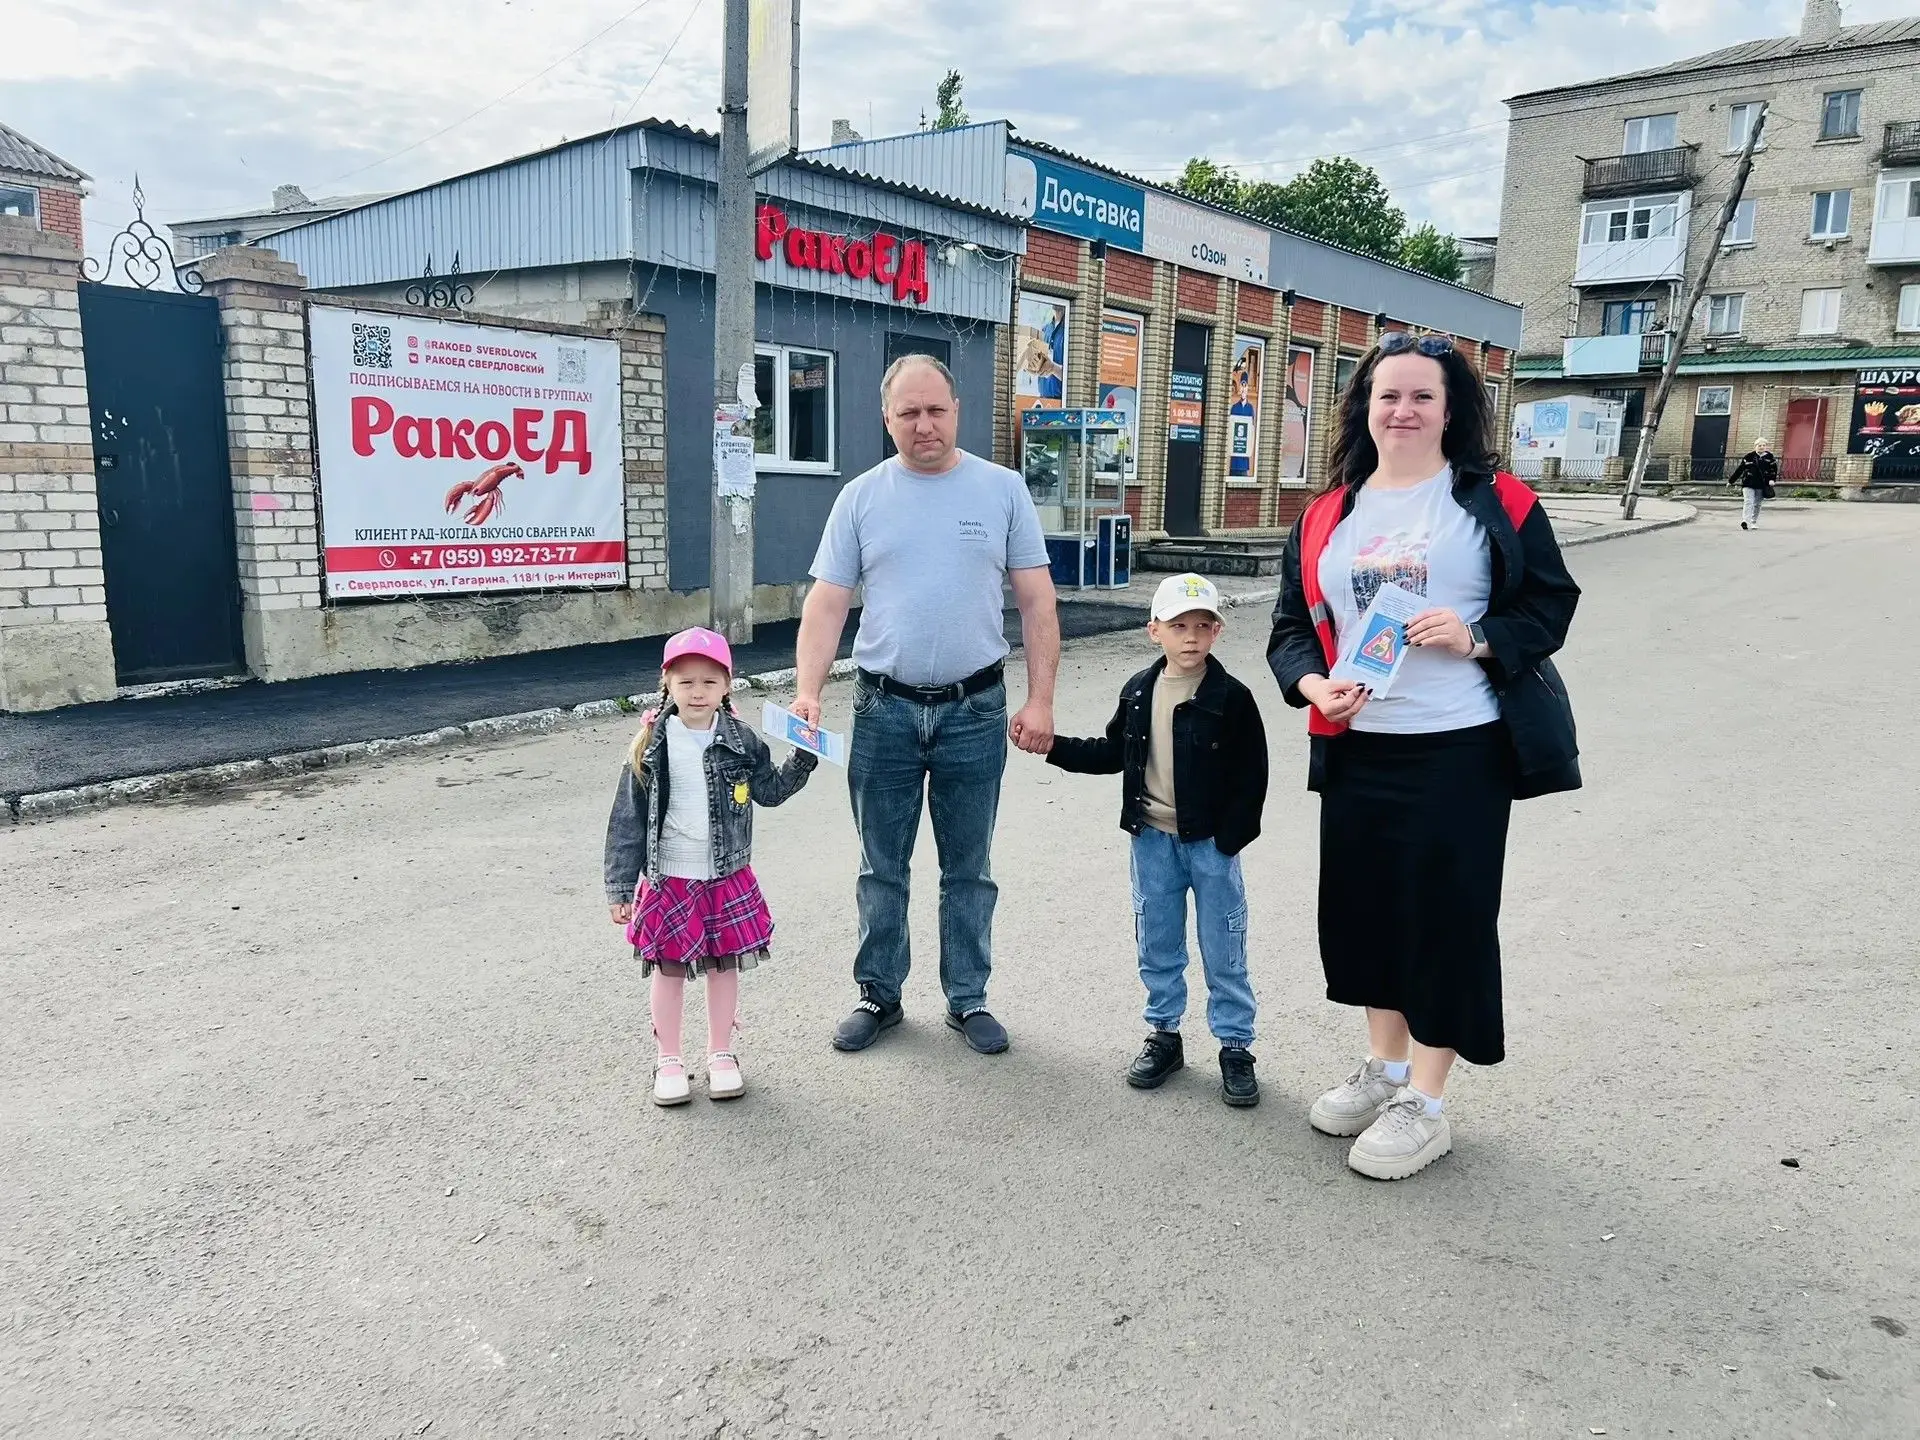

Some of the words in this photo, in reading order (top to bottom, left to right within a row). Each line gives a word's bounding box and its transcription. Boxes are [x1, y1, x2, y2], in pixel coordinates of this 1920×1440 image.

[1042, 176, 1140, 233] Доставка
[755, 204, 928, 304] РакоЕД
[1200, 243, 1227, 267] Озон
[425, 355, 466, 369] РАКОЕД
[349, 372, 461, 393] ПОДПИСЫВАЕМСЯ
[463, 382, 481, 394] НА
[482, 384, 532, 398] НОВОСТИ
[534, 387, 541, 399] В
[542, 388, 593, 403] ГРУППАХ!
[351, 396, 592, 475] РакоЕД
[354, 528, 408, 541] КЛИЕНТ
[410, 527, 478, 541] РАД-КОГДА
[480, 526, 524, 540] ВКУСНО
[526, 526, 568, 539] СВАРЕН
[570, 526, 596, 538] РАК!
[409, 550, 433, 566] +7
[439, 548, 486, 569] (959)
[491, 546, 578, 564] 992-73-77
[335, 583, 345, 592] г.
[348, 579, 427, 592] Свердловск,
[429, 578, 449, 589] ул.
[451, 575, 509, 587] Гагарина,
[512, 573, 541, 583] 118/1
[544, 572, 565, 584] (р-н
[567, 570, 621, 582] Интернат)
